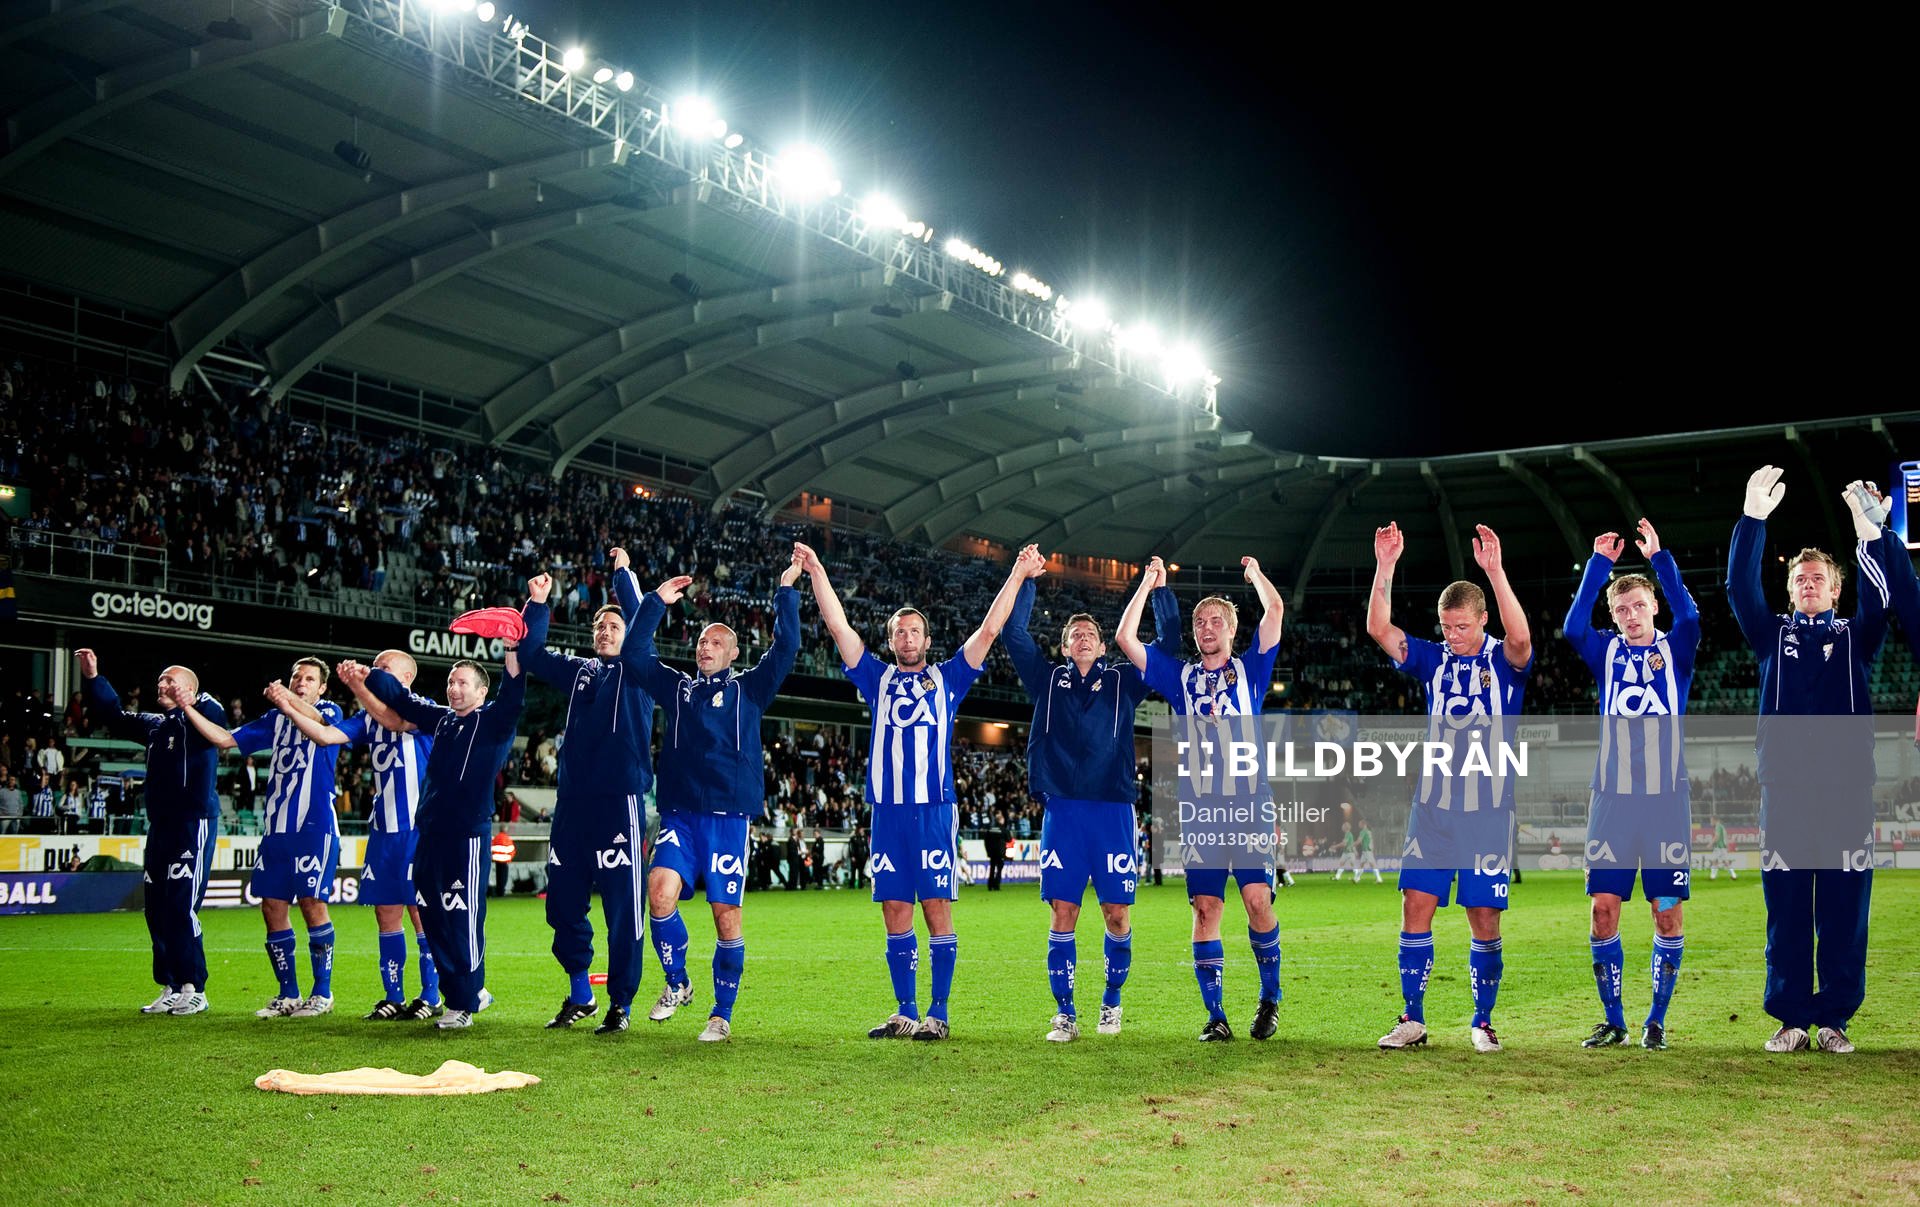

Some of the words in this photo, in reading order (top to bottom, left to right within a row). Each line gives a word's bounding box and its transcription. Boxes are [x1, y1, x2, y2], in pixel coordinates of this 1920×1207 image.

[91, 591, 214, 629] go:teborg
[409, 629, 488, 660] GAMLA
[1783, 645, 1799, 659] CA
[1459, 663, 1470, 671] ICA
[1632, 653, 1643, 661] ICA
[1057, 679, 1071, 689] ICA
[1609, 681, 1670, 718] ICA
[277, 746, 307, 773] CA
[371, 742, 404, 772] CA
[655, 828, 680, 848] CA
[596, 848, 632, 869] ICA
[1040, 849, 1063, 870] CA
[1586, 839, 1616, 863] CA
[1761, 850, 1790, 872] CA
[1842, 849, 1874, 872] ICA
[295, 855, 322, 873] ICA
[711, 852, 744, 876] ICA
[871, 853, 896, 873] CA
[1107, 853, 1138, 874] ICA
[1474, 853, 1509, 876] ICA
[307, 876, 317, 888] 9
[726, 881, 737, 894] 8
[934, 874, 949, 888] 14
[1122, 879, 1135, 893] 19
[1491, 884, 1508, 898] 10
[271, 943, 289, 970] SKF
[661, 940, 673, 966] SKF
[1066, 959, 1075, 989] SKF
[1612, 962, 1622, 997] SKF
